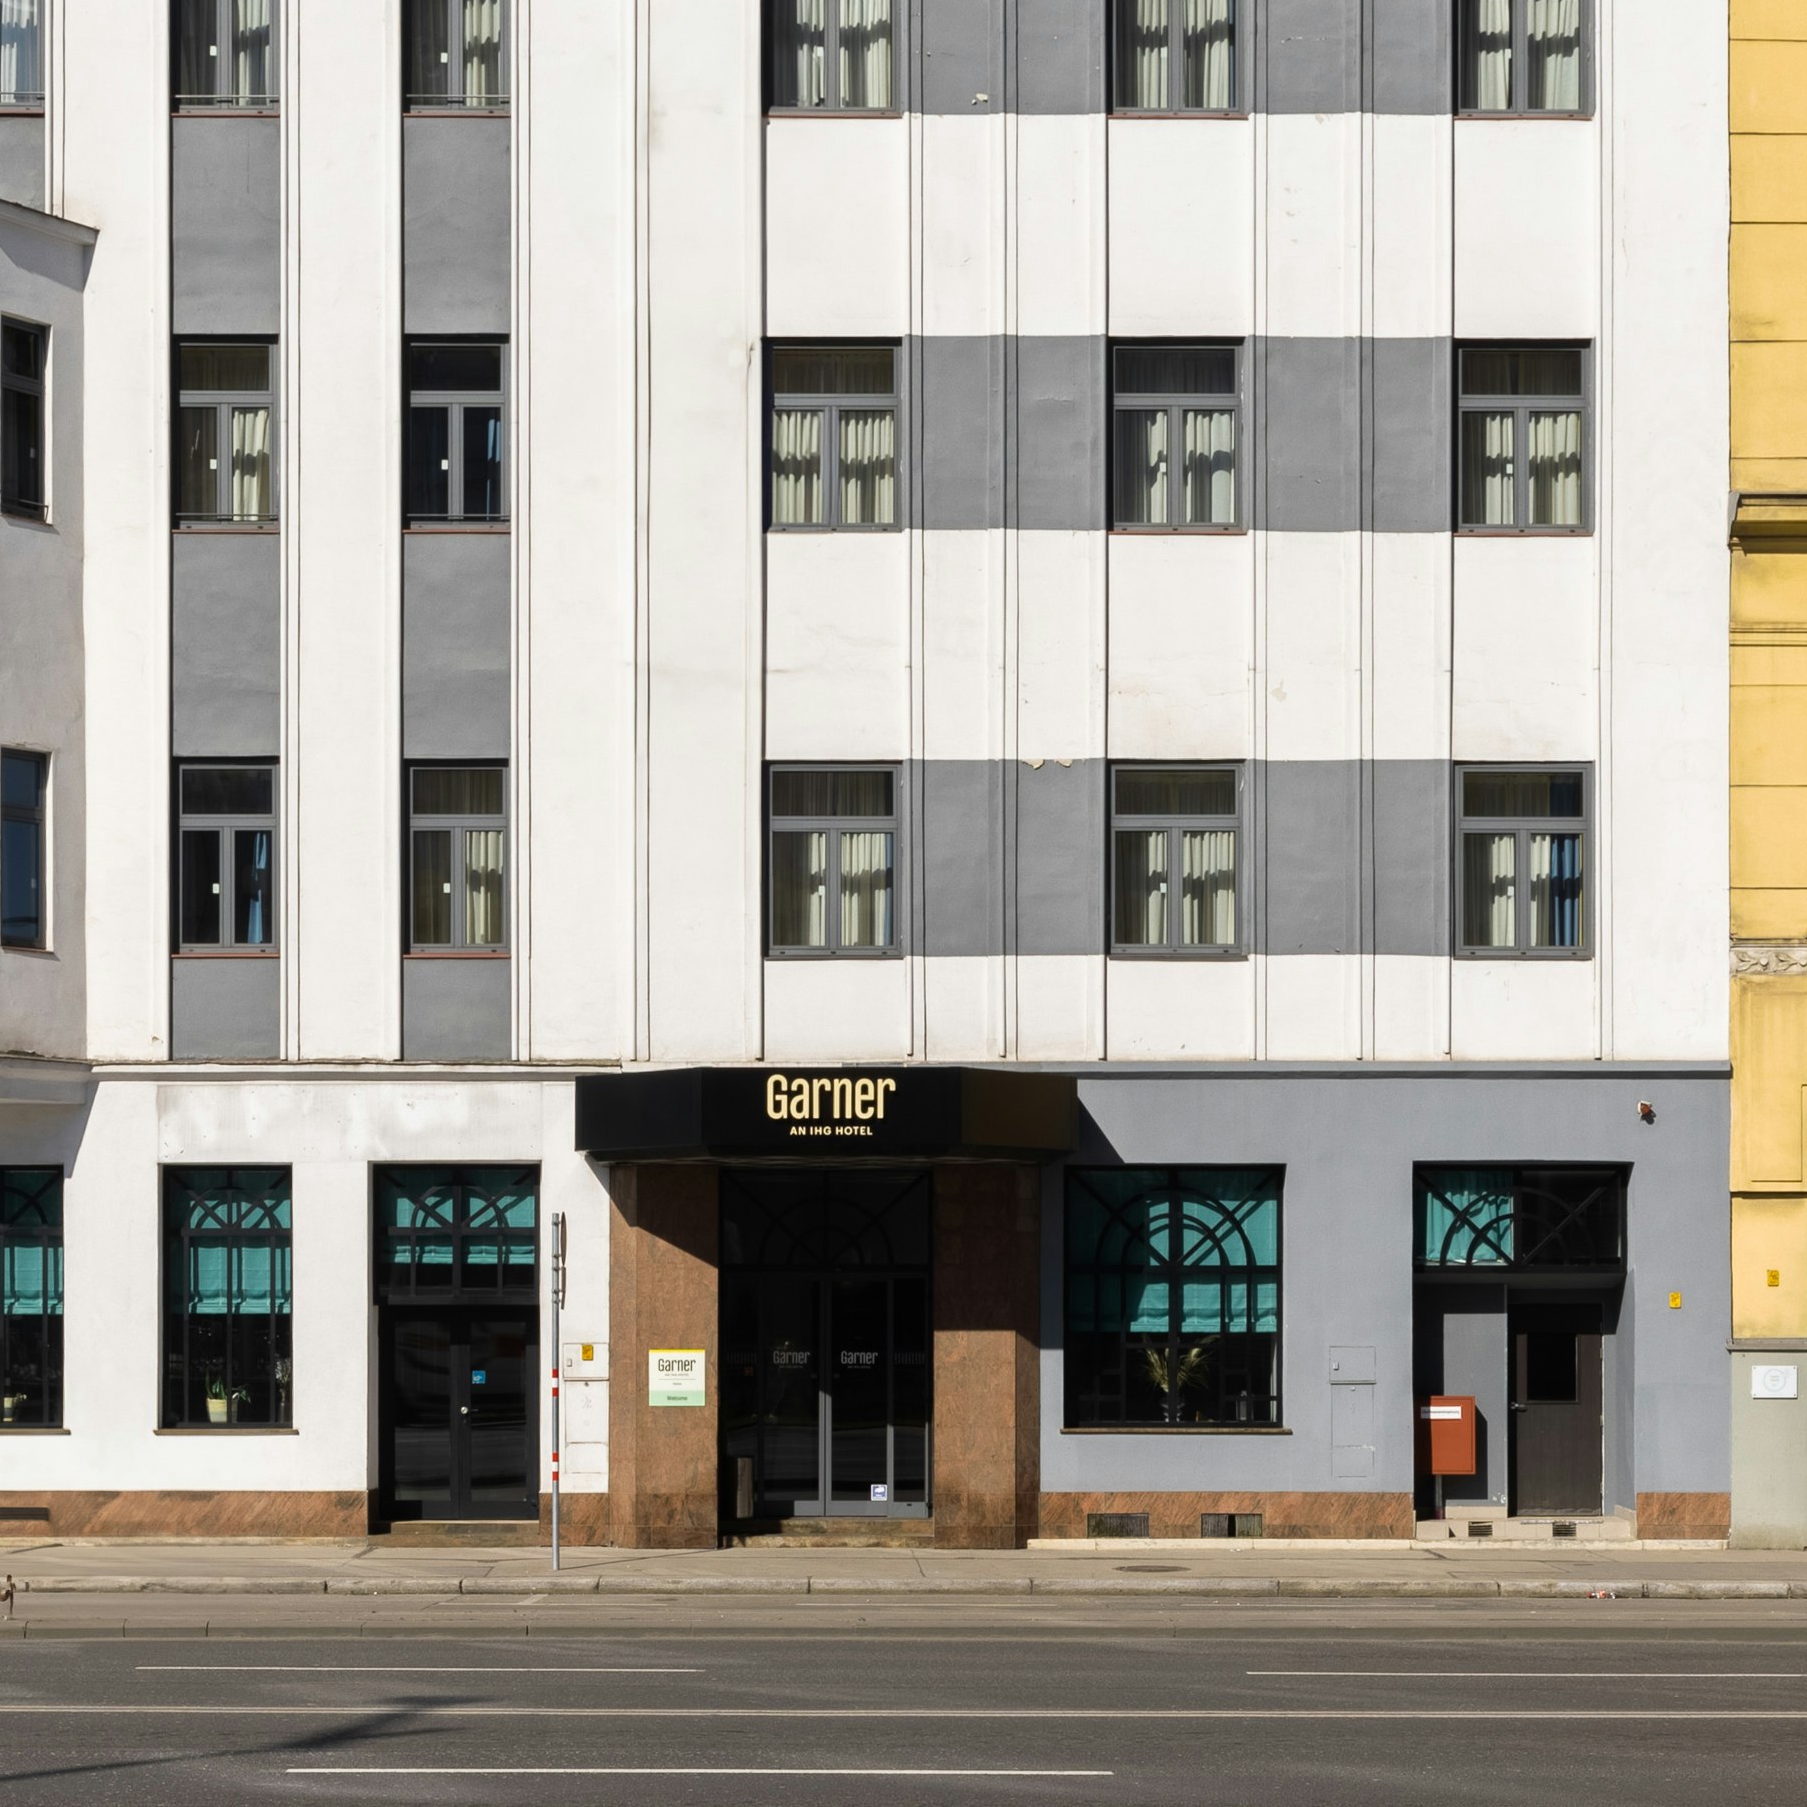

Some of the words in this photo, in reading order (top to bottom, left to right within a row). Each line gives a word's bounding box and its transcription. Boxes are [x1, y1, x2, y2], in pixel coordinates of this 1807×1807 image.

[766, 1074, 897, 1120] Garner
[789, 1126, 806, 1136] AN
[810, 1126, 832, 1136] IHG
[835, 1126, 874, 1136] HOTEL
[657, 1358, 696, 1372] Garner
[772, 1349, 811, 1365] Garner
[840, 1349, 878, 1365] Garner
